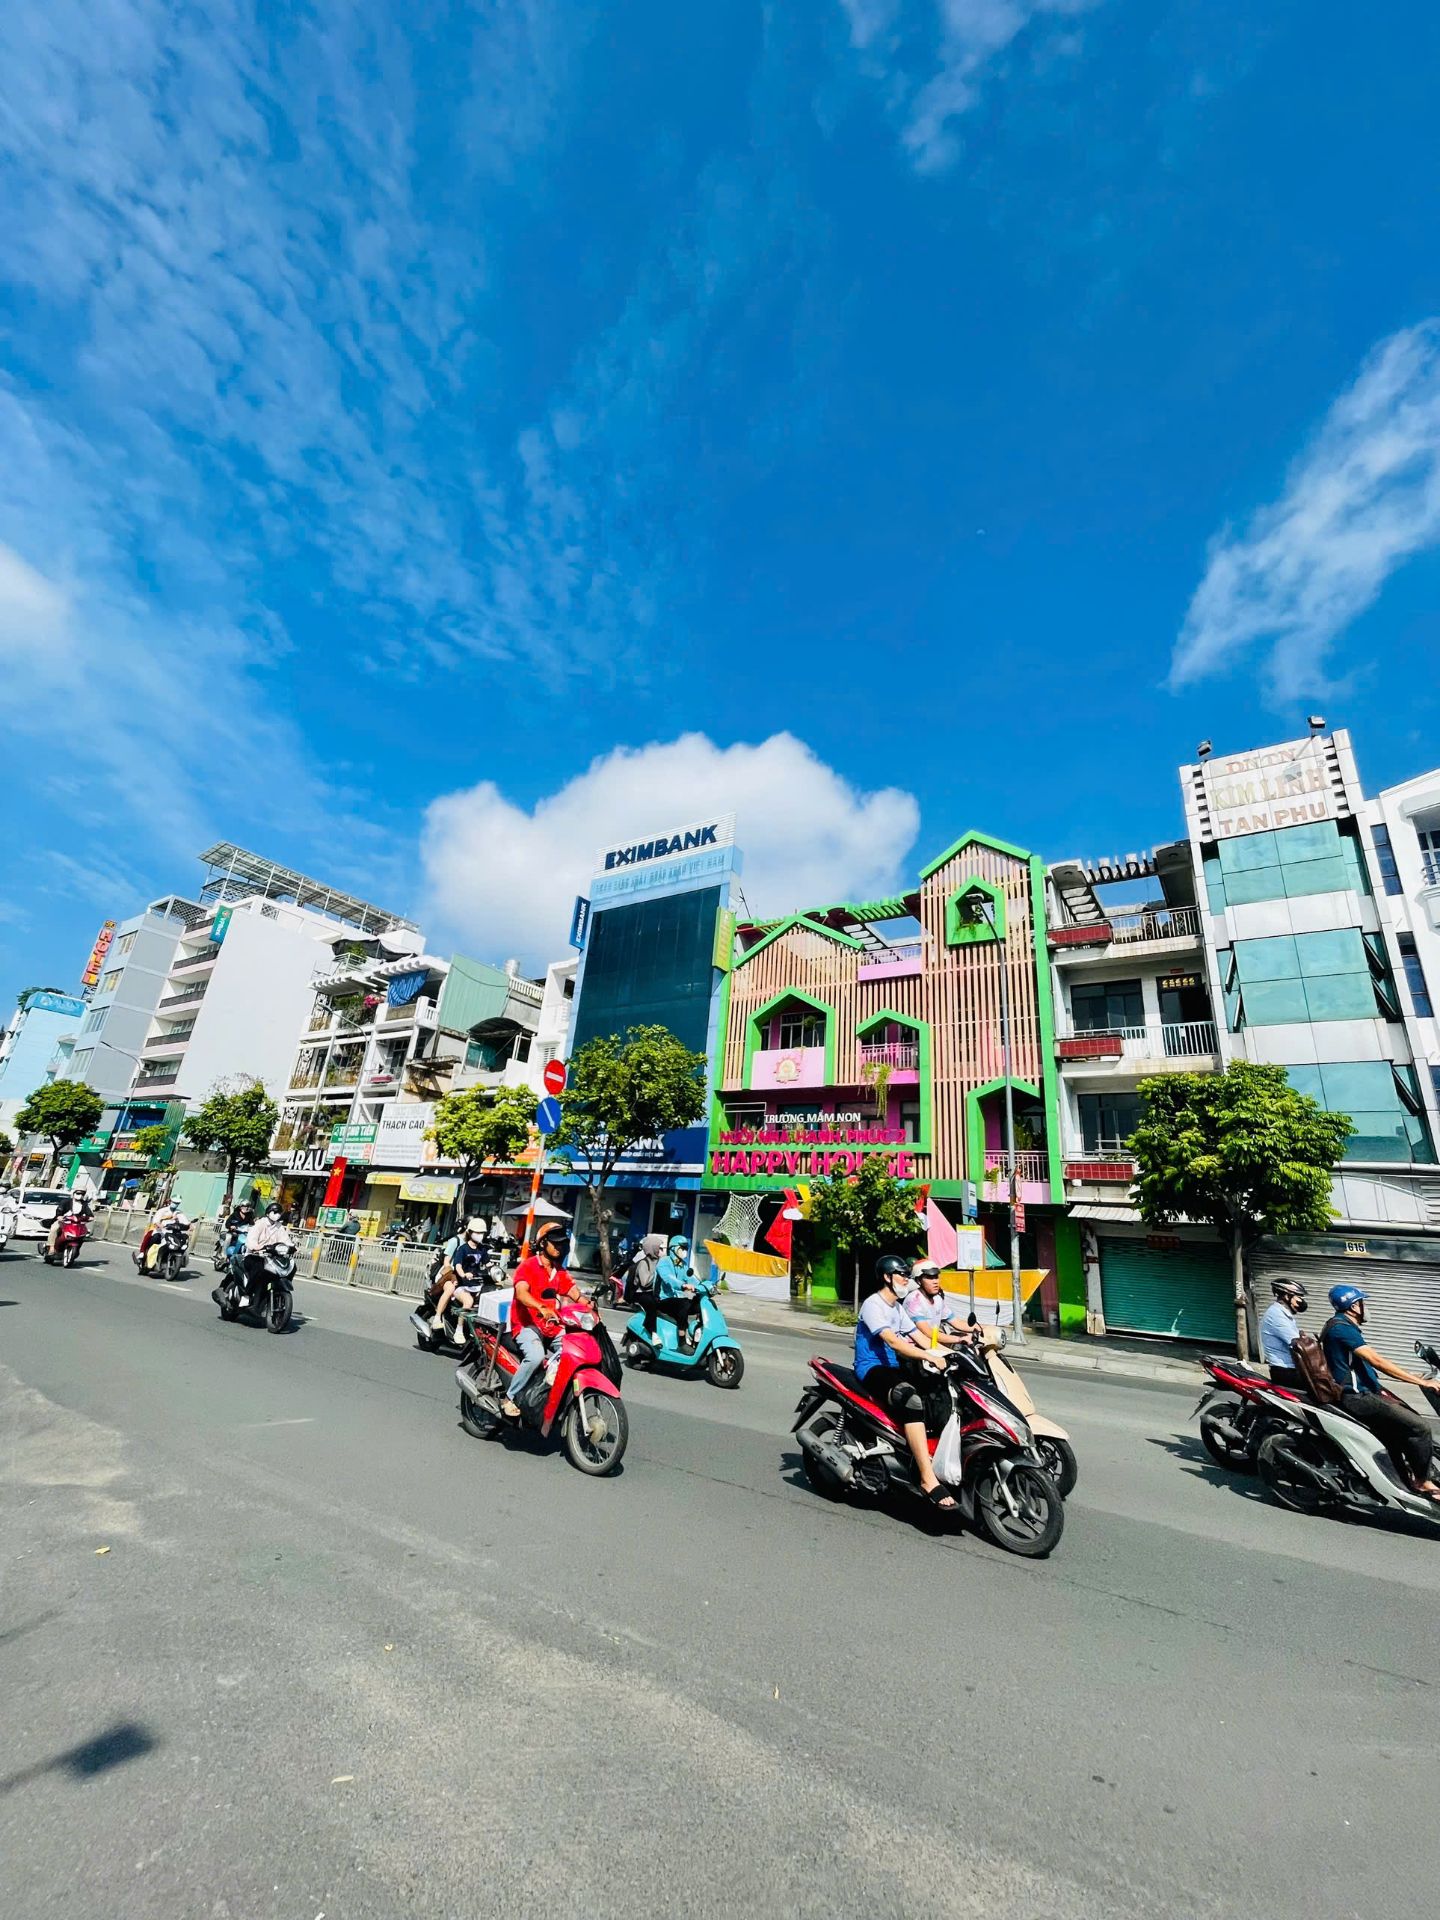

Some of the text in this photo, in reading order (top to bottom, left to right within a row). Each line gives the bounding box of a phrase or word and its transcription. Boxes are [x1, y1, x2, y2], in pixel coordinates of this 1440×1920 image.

[1210, 782, 1257, 810] KIM
[604, 824, 718, 870] EXIMBANK
[575, 902, 587, 943] EXIMBANK
[81, 928, 114, 986] HOTEL
[409, 1119, 425, 1130] CAO
[837, 1112, 861, 1123] NON
[895, 1129, 907, 1144] 2
[712, 1150, 800, 1175] HAPPY
[1346, 1241, 1366, 1254] 615
